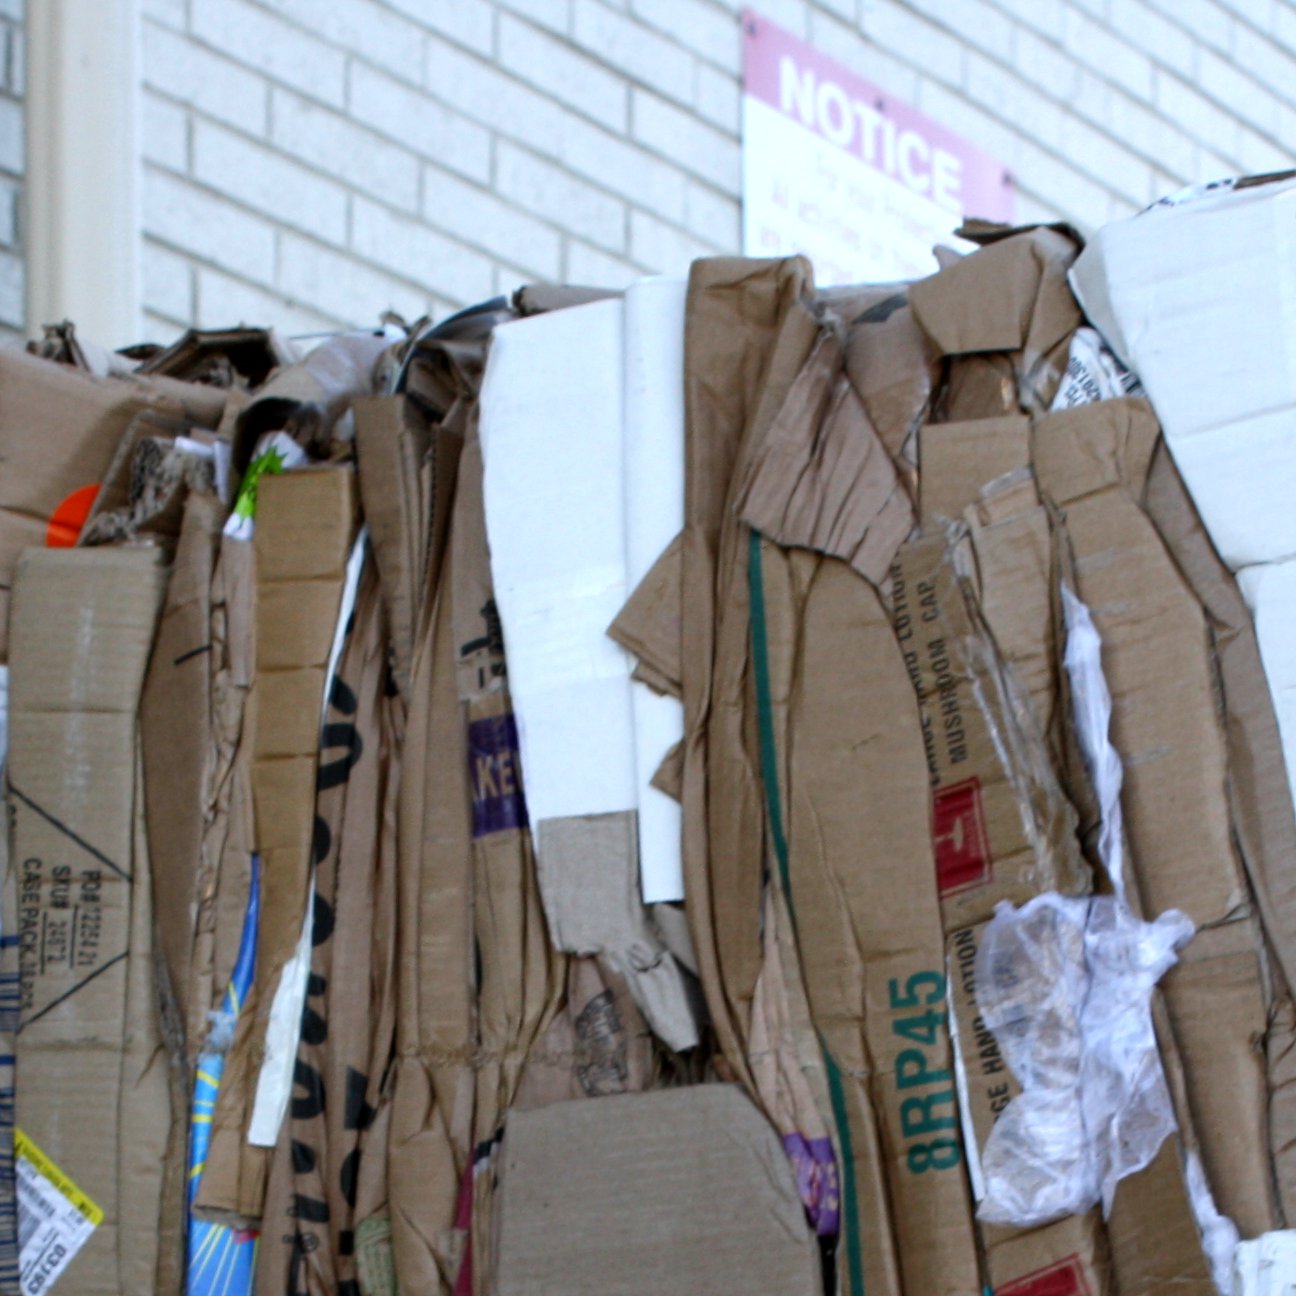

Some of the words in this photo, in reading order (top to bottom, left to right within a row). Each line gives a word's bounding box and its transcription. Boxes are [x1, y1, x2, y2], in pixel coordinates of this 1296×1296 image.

[779, 56, 963, 216] NOTICE
[917, 580, 938, 623] CAP
[927, 638, 967, 765] MUSHROOM
[471, 750, 515, 803] KE
[21, 857, 43, 904] CASE
[49, 864, 71, 909] SKU#
[888, 969, 963, 1175] 8RP45
